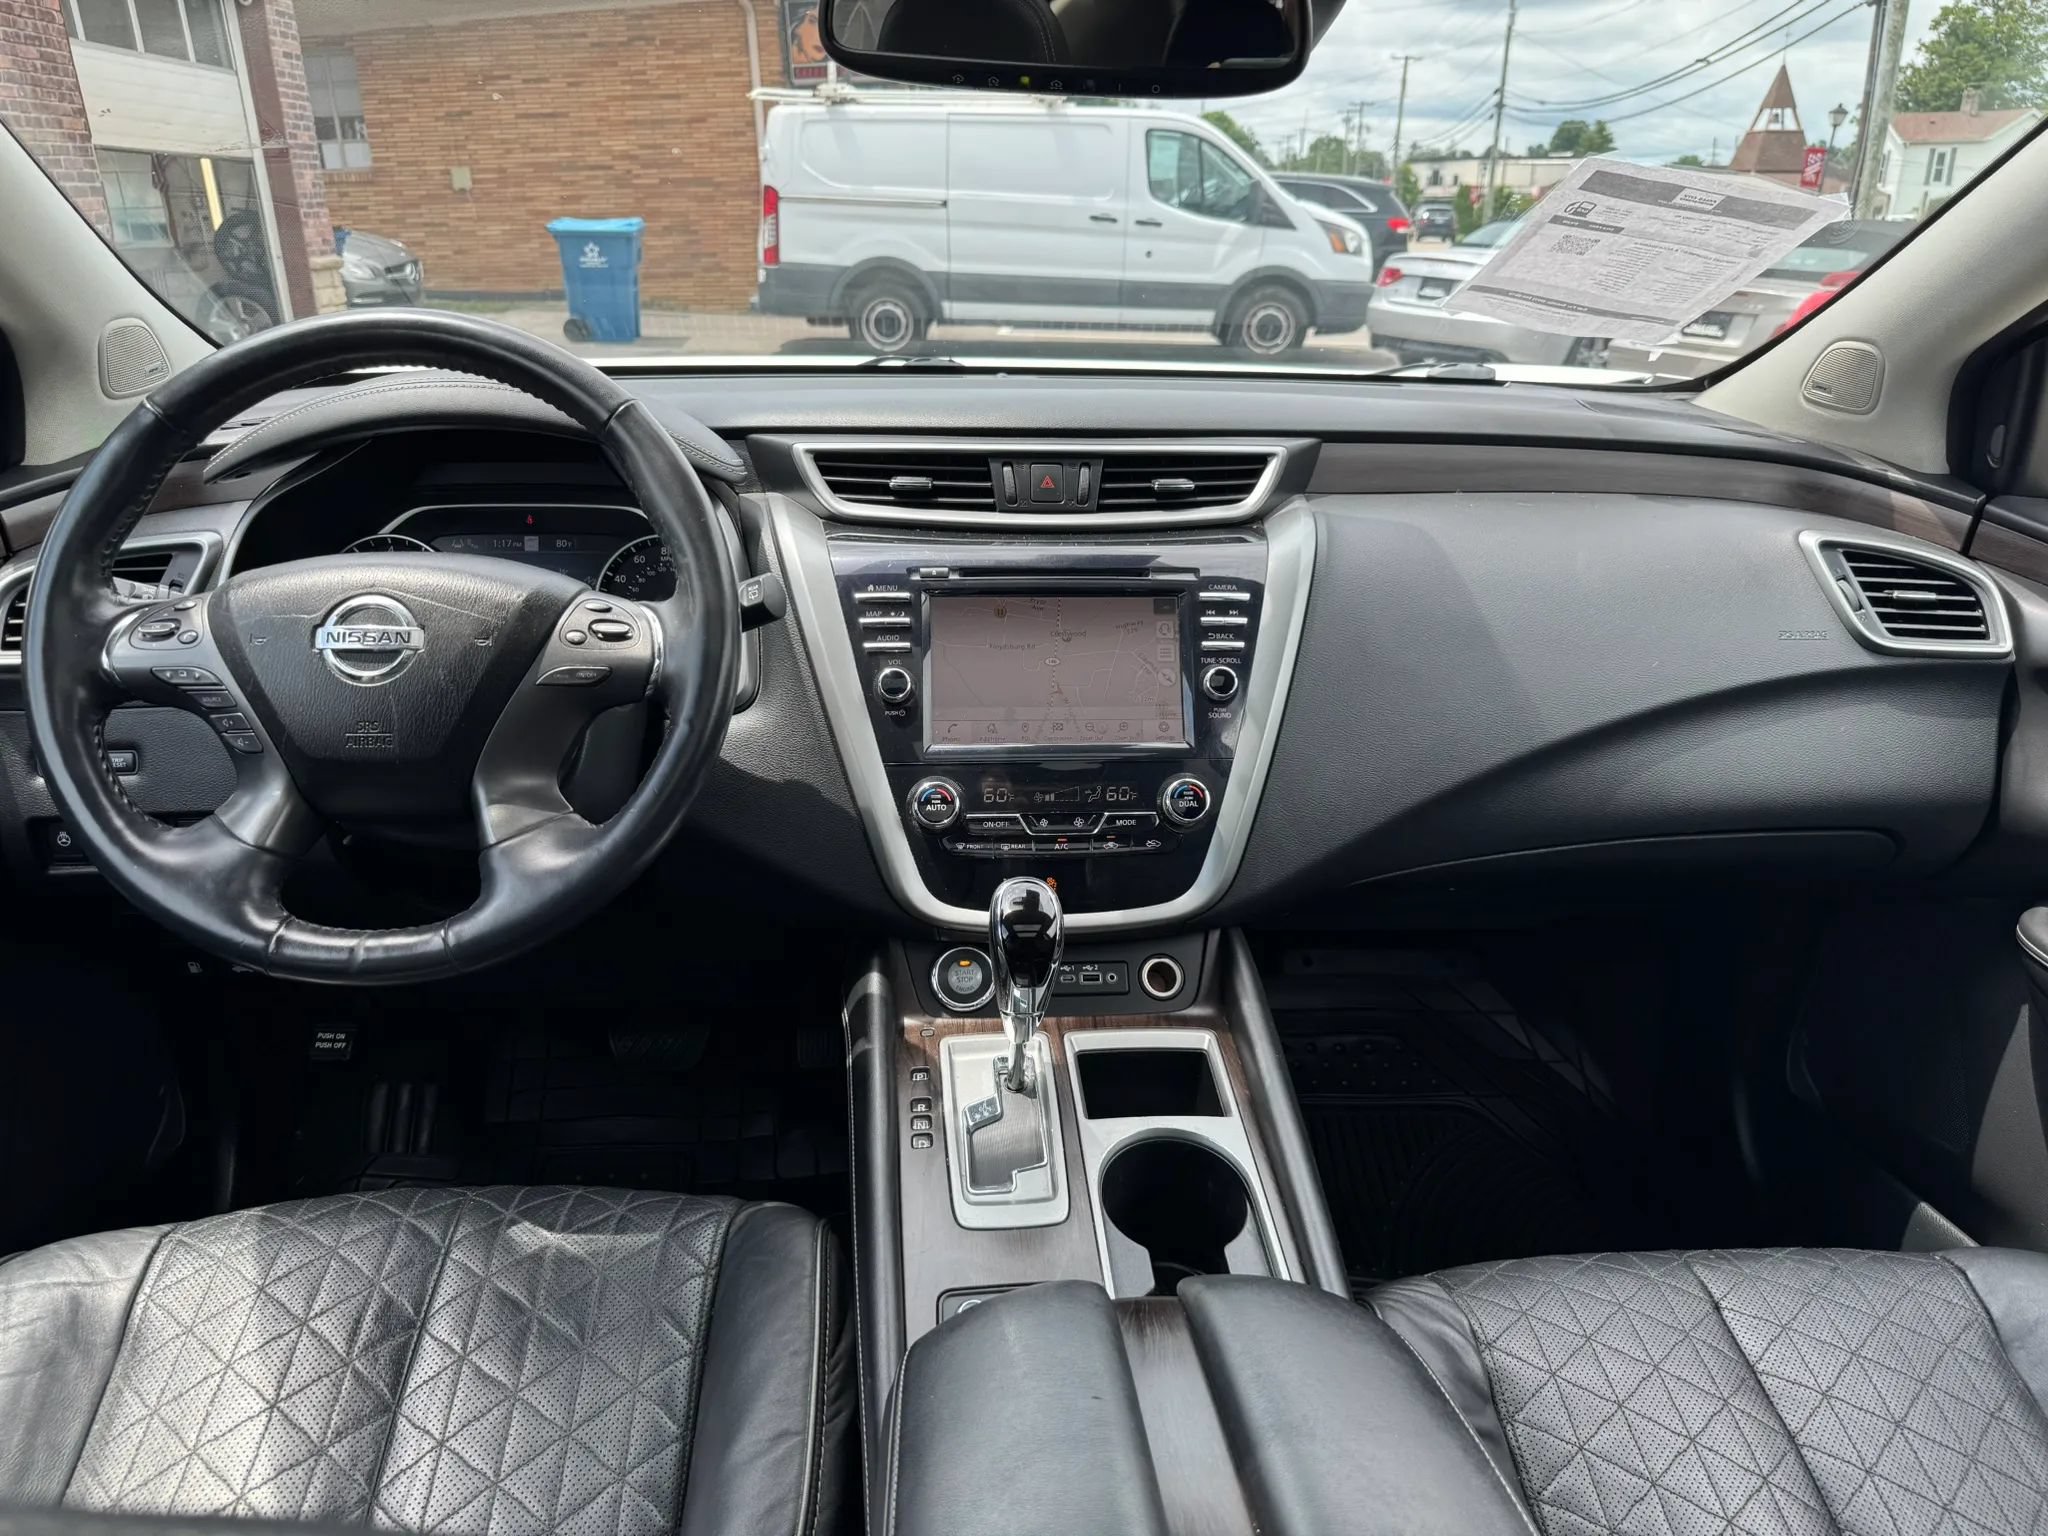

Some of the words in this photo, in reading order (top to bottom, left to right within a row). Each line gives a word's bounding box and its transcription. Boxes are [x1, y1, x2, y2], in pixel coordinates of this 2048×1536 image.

[633, 555, 646, 564] 60
[614, 574, 627, 583] 40
[325, 631, 412, 644] NISSAN
[356, 720, 381, 733] SRS
[345, 735, 393, 748] AIRBAG
[926, 804, 947, 812] AUTO
[1178, 800, 1199, 808] DUAL
